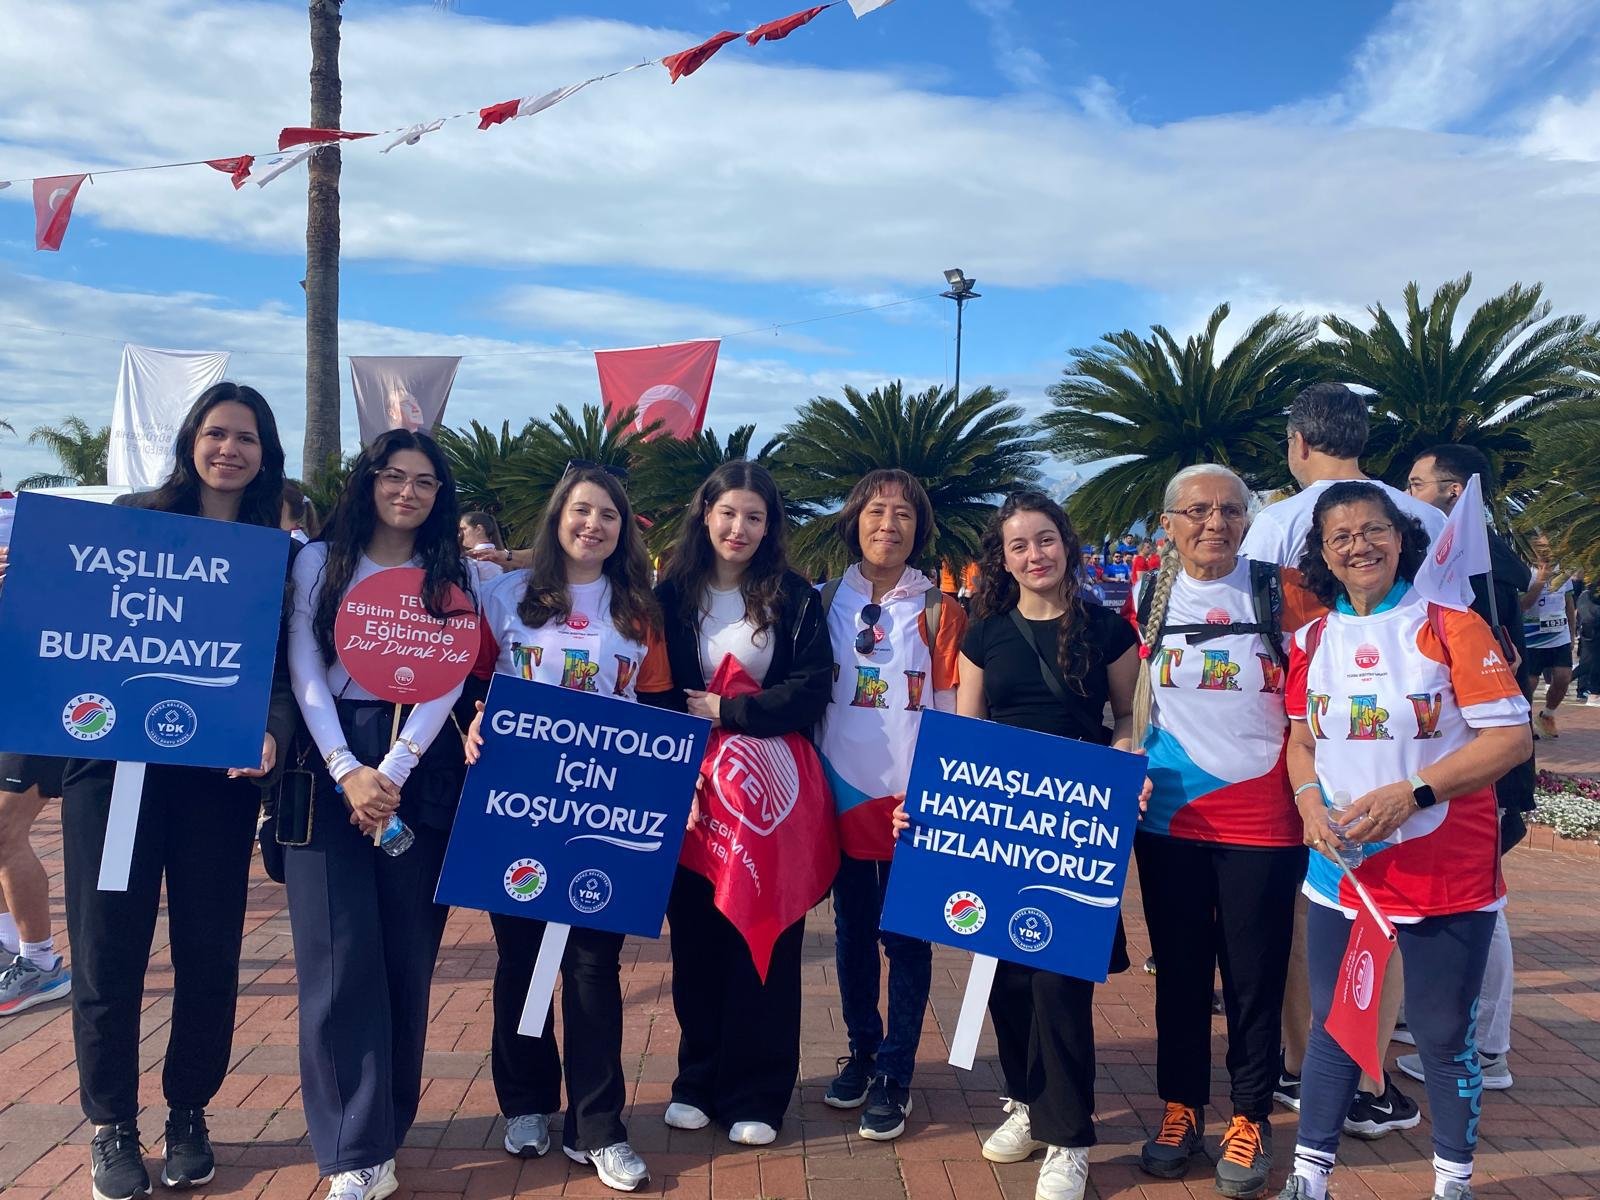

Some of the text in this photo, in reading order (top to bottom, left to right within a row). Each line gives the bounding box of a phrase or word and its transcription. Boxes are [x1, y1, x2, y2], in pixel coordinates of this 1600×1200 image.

[68, 543, 231, 585] YAŞLILAR
[110, 584, 184, 627] İÇİN
[346, 602, 394, 618] Eğitim
[365, 620, 455, 645] Eğitimde
[39, 630, 242, 670] BURADAYIZ
[344, 635, 470, 664] Dur Durak Yok
[1356, 656, 1377, 665] TEV
[67, 694, 113, 713] KEPEZ
[64, 714, 114, 739] BELEDİYESİ
[157, 723, 184, 733] YDK
[491, 708, 696, 764] GERONTOLOJİ
[555, 753, 618, 793] İÇİN
[939, 756, 1111, 811] YAVAŞLAYAN
[485, 789, 668, 838] KOŞUYORUZ
[919, 791, 1119, 849] HAYATLAR İÇİN
[709, 819, 743, 855] EĞİTM
[509, 859, 545, 876] KEPEZ
[912, 825, 1116, 887] HIZLANIYORUZ
[505, 876, 545, 899] BELEDİYESİ
[579, 889, 600, 901] YDK
[949, 893, 984, 911] KEPEZ
[946, 908, 984, 934] BELEDİYESİ
[1019, 927, 1041, 940] YDK
